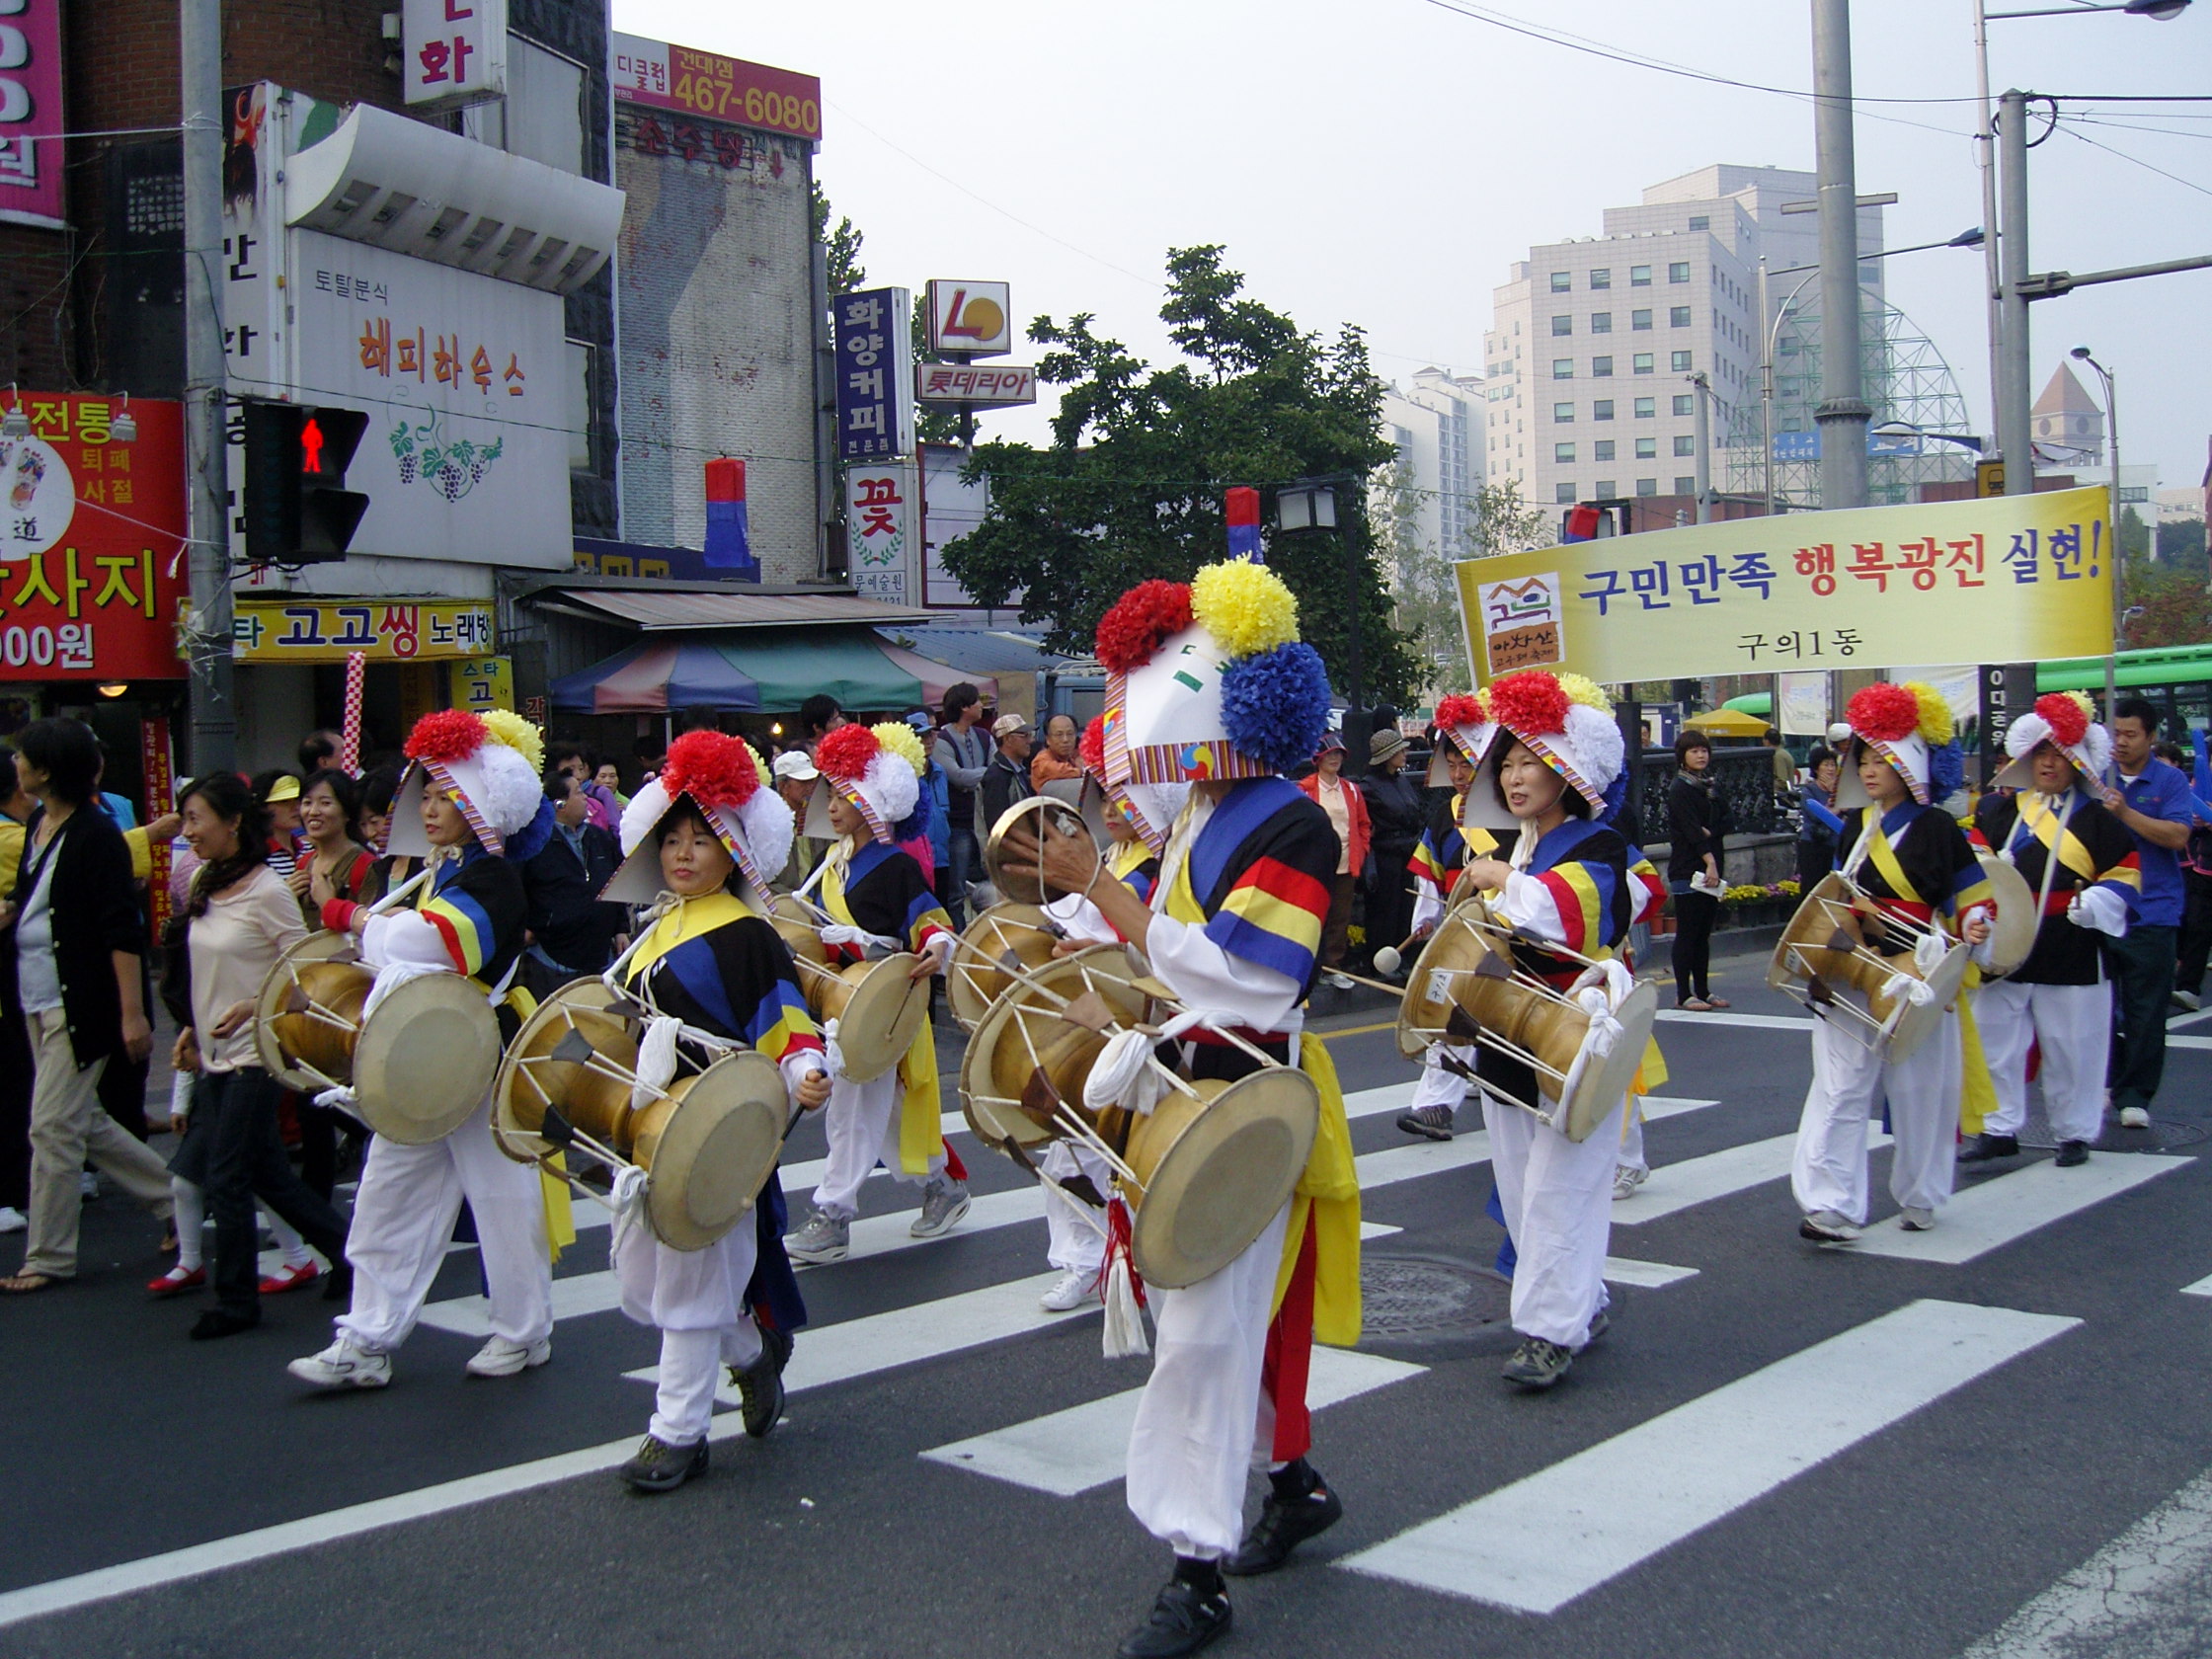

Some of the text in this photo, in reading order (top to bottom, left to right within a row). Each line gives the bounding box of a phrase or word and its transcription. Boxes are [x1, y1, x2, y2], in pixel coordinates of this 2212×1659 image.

[676, 49, 734, 79] 건대점
[674, 73, 820, 133] 467-6080
[315, 270, 388, 306] 토탈분식
[359, 316, 525, 396] 해피하우스
[844, 298, 885, 435] 화양커피
[926, 369, 1029, 396] 롯데리아
[81, 448, 130, 473] 퇴폐
[83, 479, 133, 504] 사절
[853, 477, 904, 537] 꽃
[13, 516, 44, 541] 道
[1578, 519, 2101, 616] 구민만족 행복광진 실현!
[0, 621, 94, 669] 00원
[277, 604, 419, 659] 고고씽
[431, 613, 492, 644] 노래방
[1492, 630, 1554, 652] 아차산
[1737, 628, 1862, 662] 구의1동
[462, 661, 498, 677] 스타
